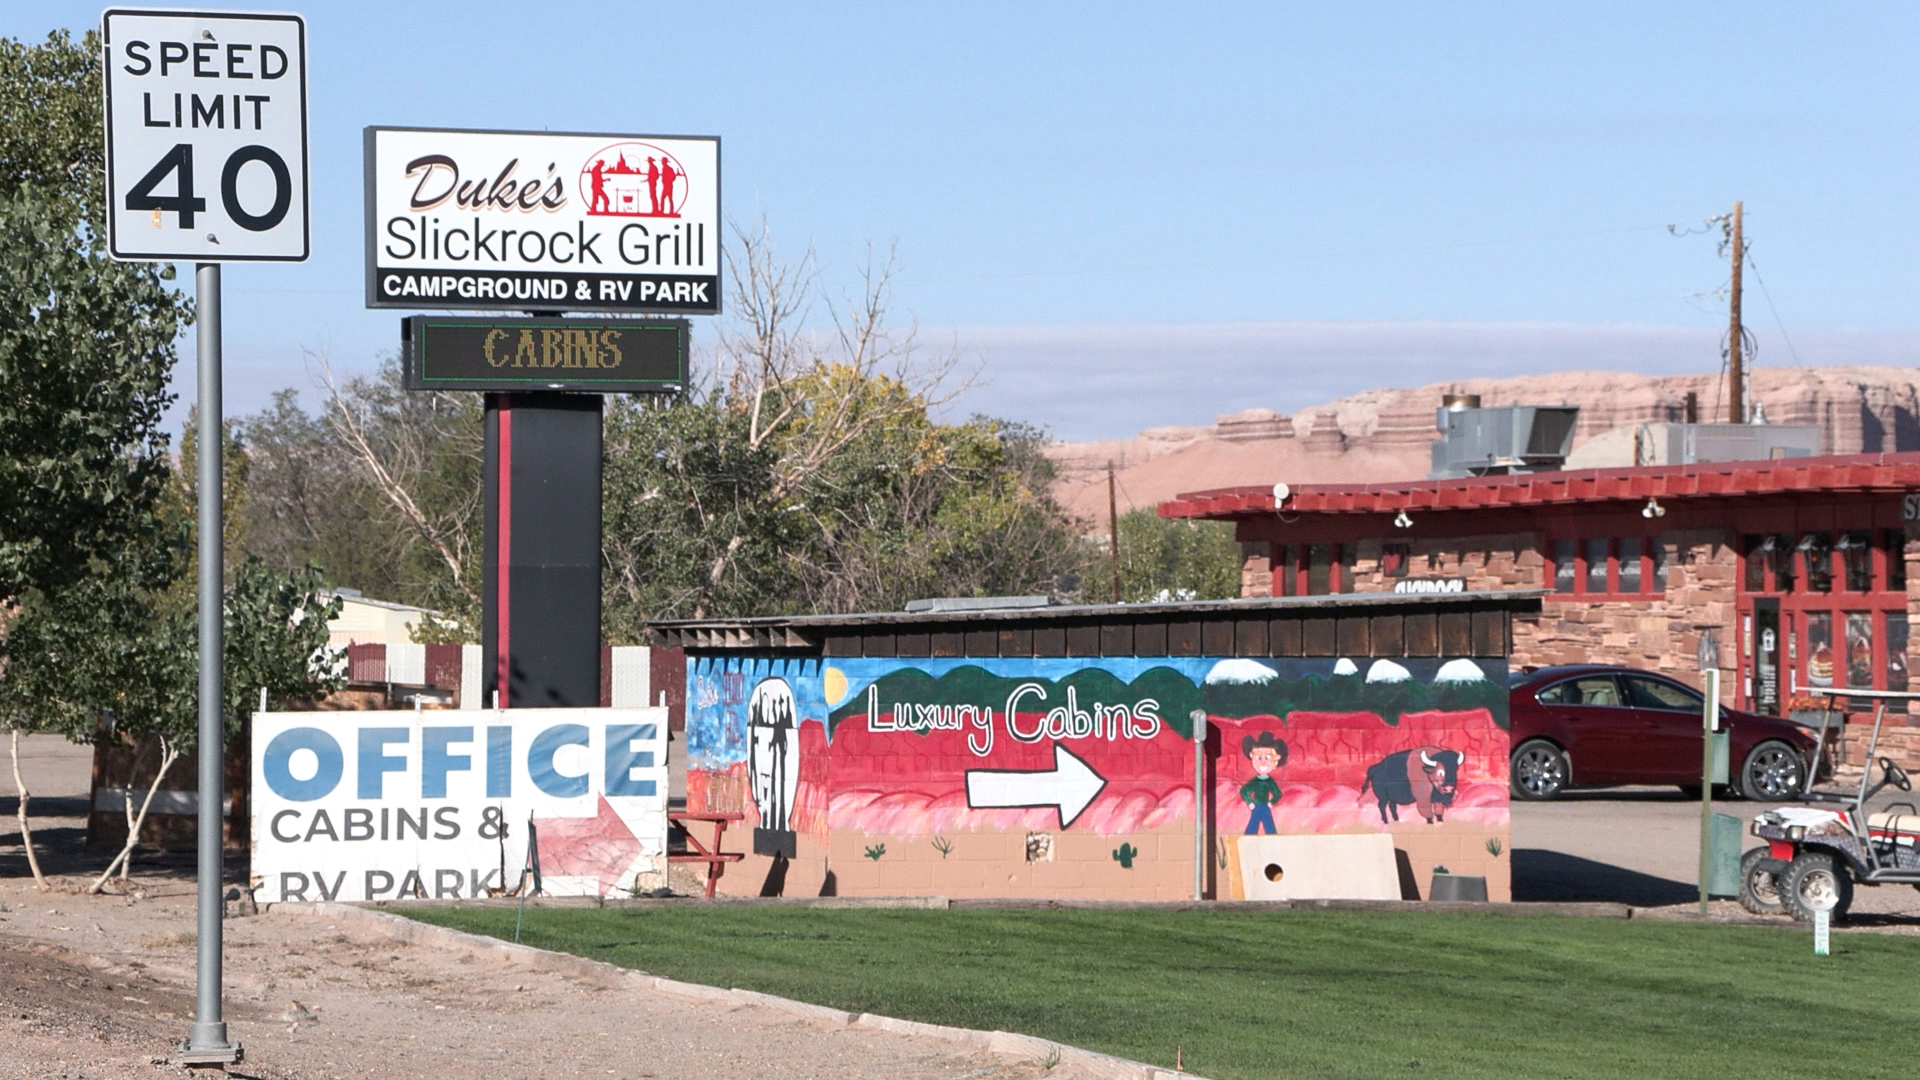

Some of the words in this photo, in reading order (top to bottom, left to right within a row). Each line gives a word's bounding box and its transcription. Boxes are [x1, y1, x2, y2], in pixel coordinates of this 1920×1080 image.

[124, 40, 288, 79] SPEED
[143, 93, 271, 130] LIMIT
[125, 143, 292, 232] 40
[405, 153, 567, 212] Duke's
[385, 216, 602, 264] Slickrock
[618, 223, 704, 267] Grill
[383, 275, 567, 300] CAMPGROUND
[575, 280, 592, 301] &
[600, 281, 633, 301] RV
[640, 281, 709, 303] PARK
[484, 328, 622, 369] CABINS
[868, 684, 993, 757] Luxury
[1006, 683, 1161, 744] Cabins
[262, 723, 657, 802] OFFICE
[271, 806, 461, 843] CABINS
[478, 806, 510, 842] &
[280, 870, 347, 902] RV
[365, 868, 500, 900] PARK
